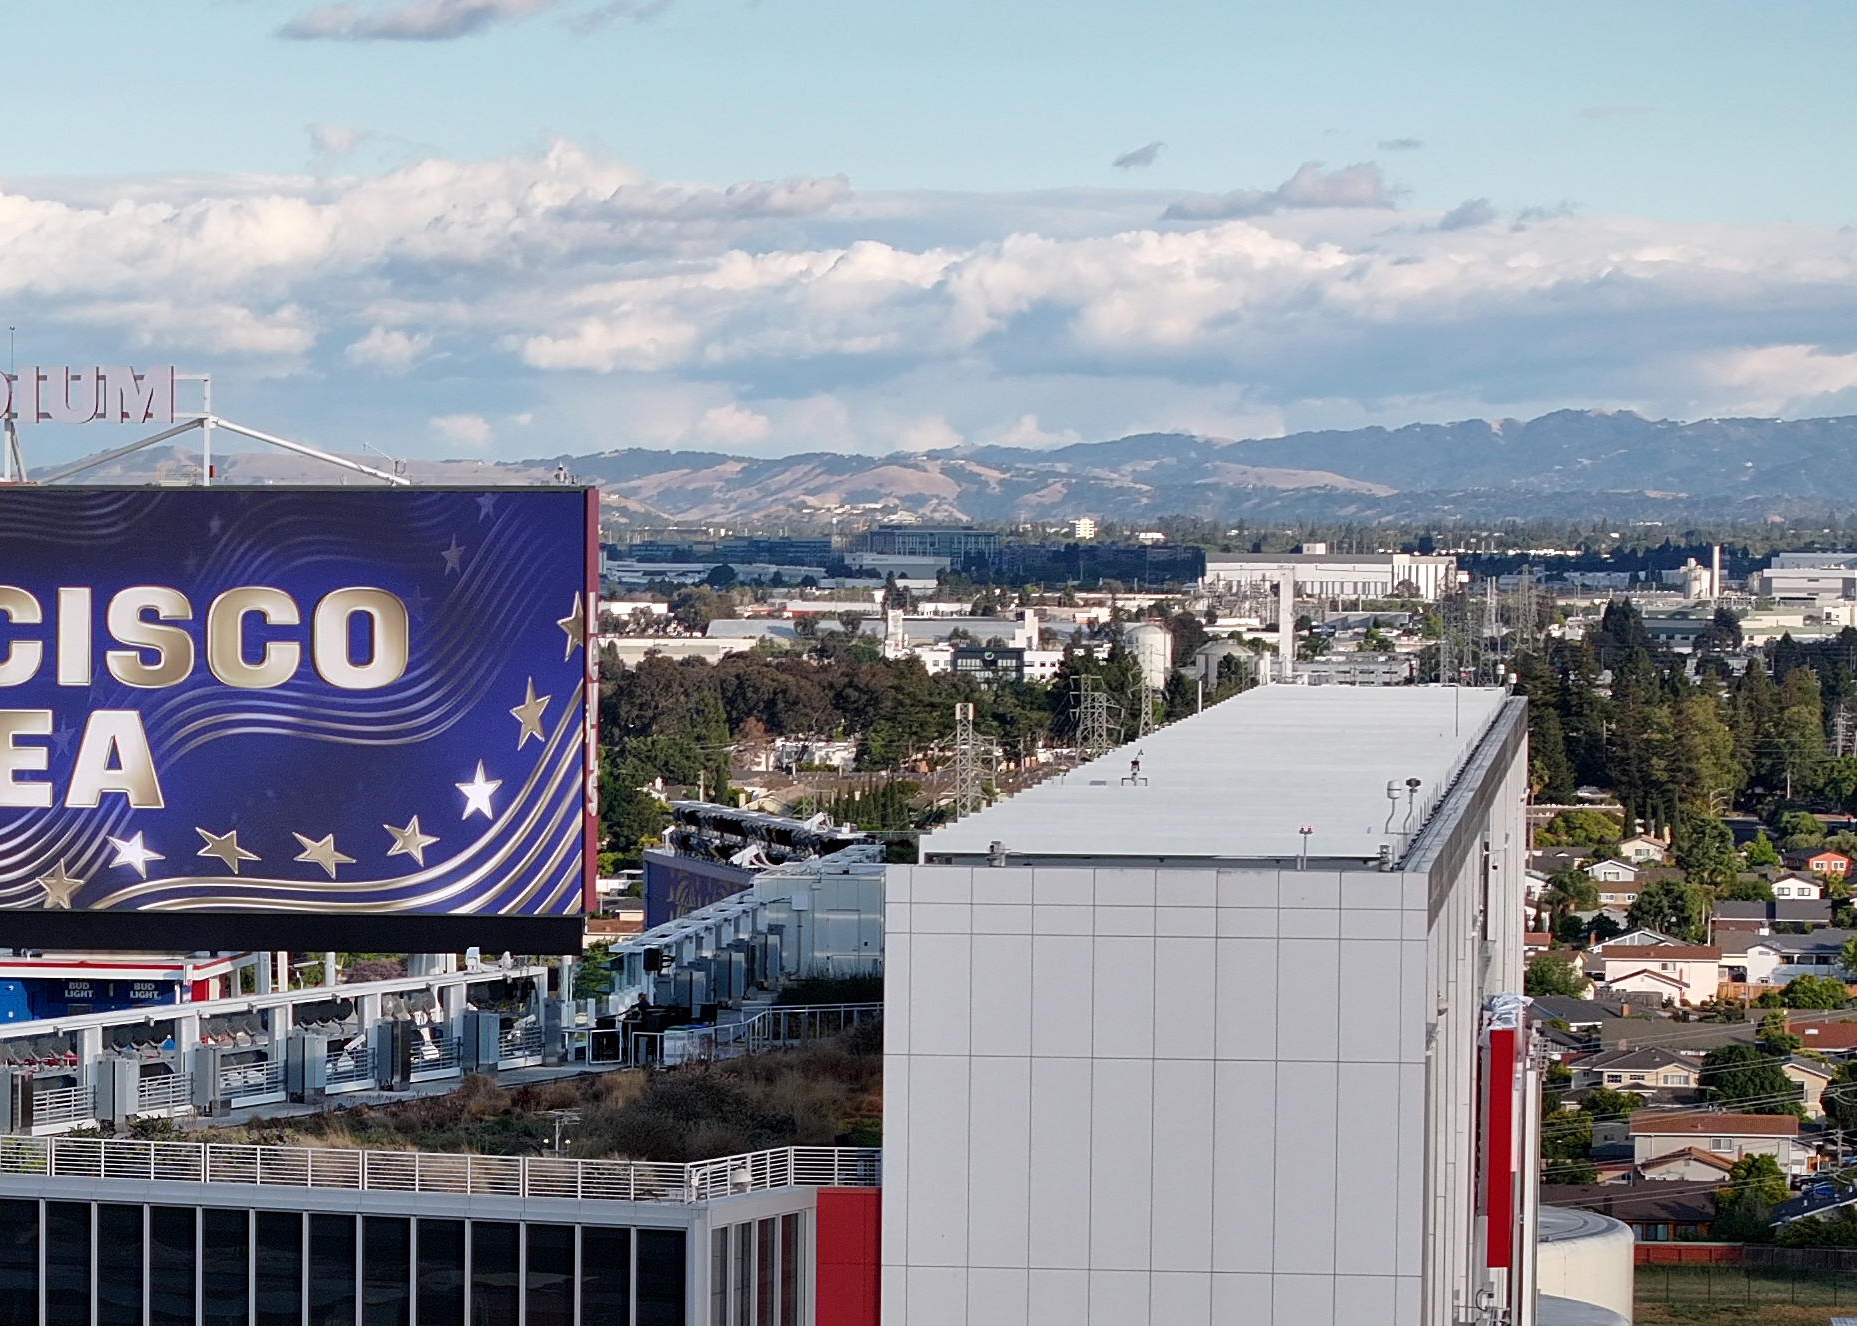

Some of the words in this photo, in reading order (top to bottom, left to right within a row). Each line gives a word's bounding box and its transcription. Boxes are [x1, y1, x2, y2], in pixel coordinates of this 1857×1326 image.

[68, 982, 90, 990] BUD
[133, 982, 155, 991] BUD
[64, 990, 94, 998] LIGHT
[129, 990, 160, 999] LIGHT
